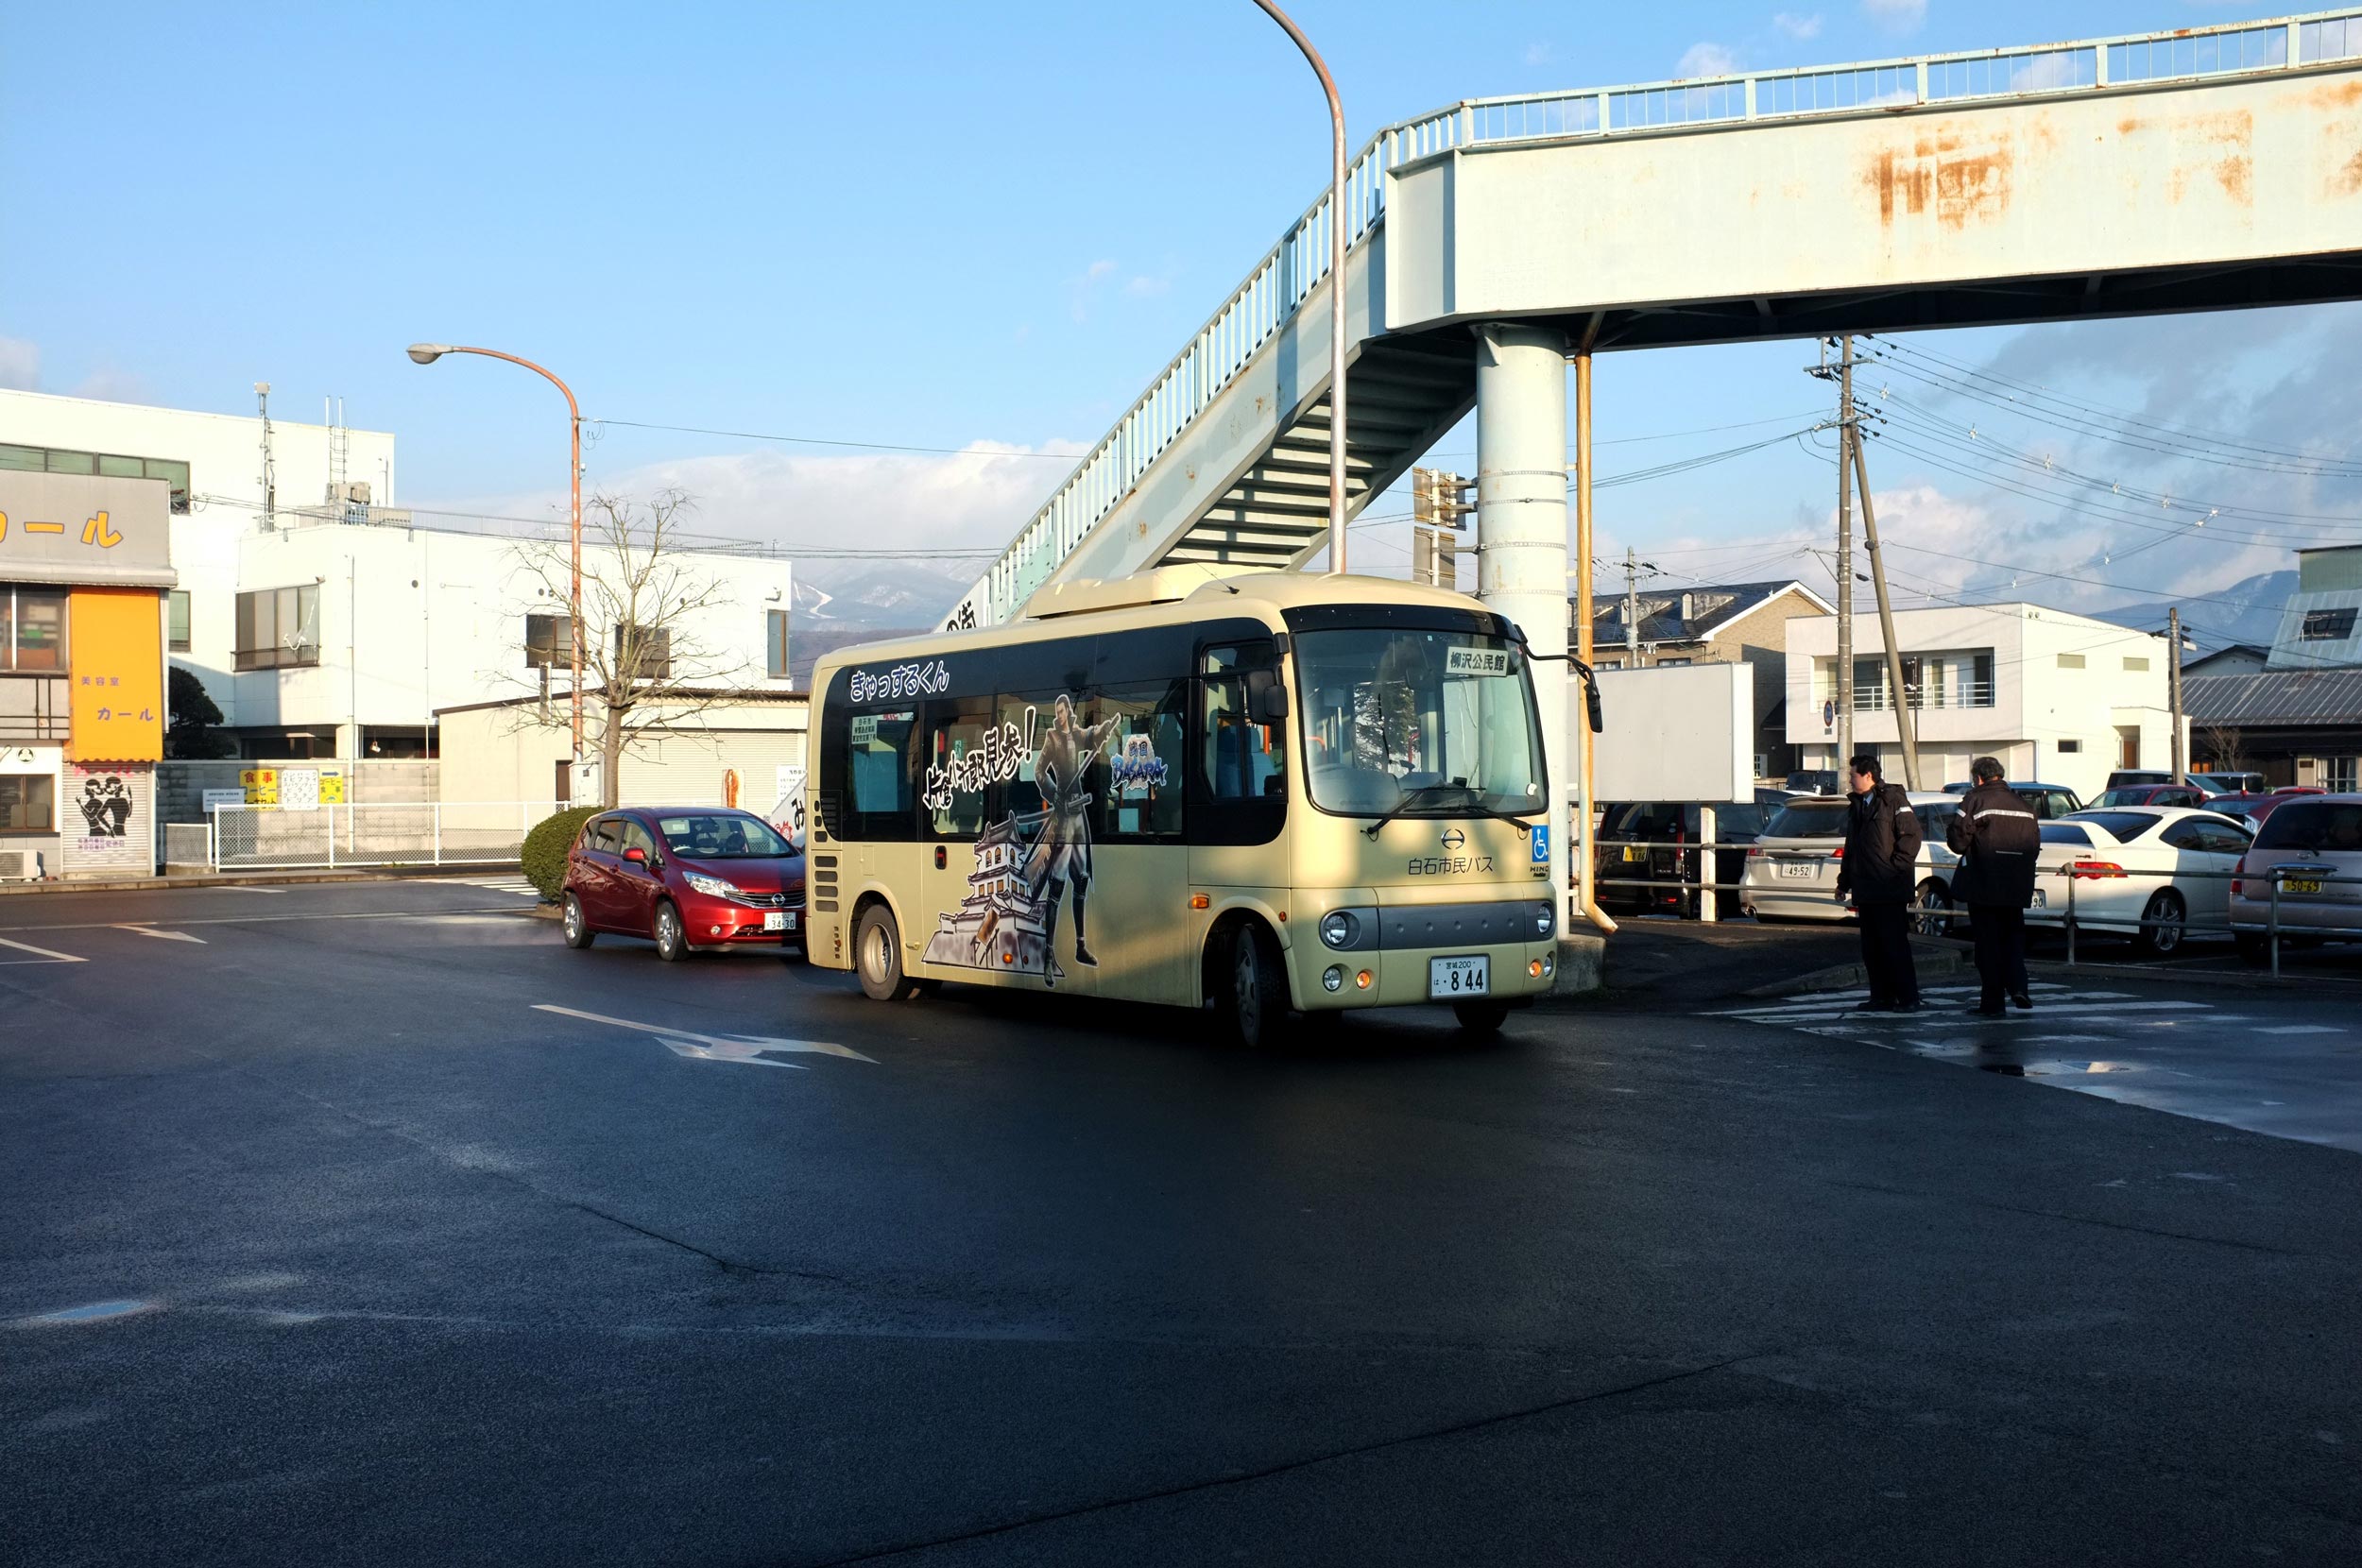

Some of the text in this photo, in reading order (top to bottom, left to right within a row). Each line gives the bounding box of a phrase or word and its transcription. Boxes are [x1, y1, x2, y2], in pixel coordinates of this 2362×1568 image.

[0, 510, 124, 548] ール
[1450, 651, 1505, 671] 柳沢公民館
[850, 660, 950, 702] きゃっするくん
[97, 707, 154, 721] カール
[244, 771, 273, 783] 食事
[1408, 857, 1494, 875] 白石市民バス
[771, 919, 795, 929] 34-30
